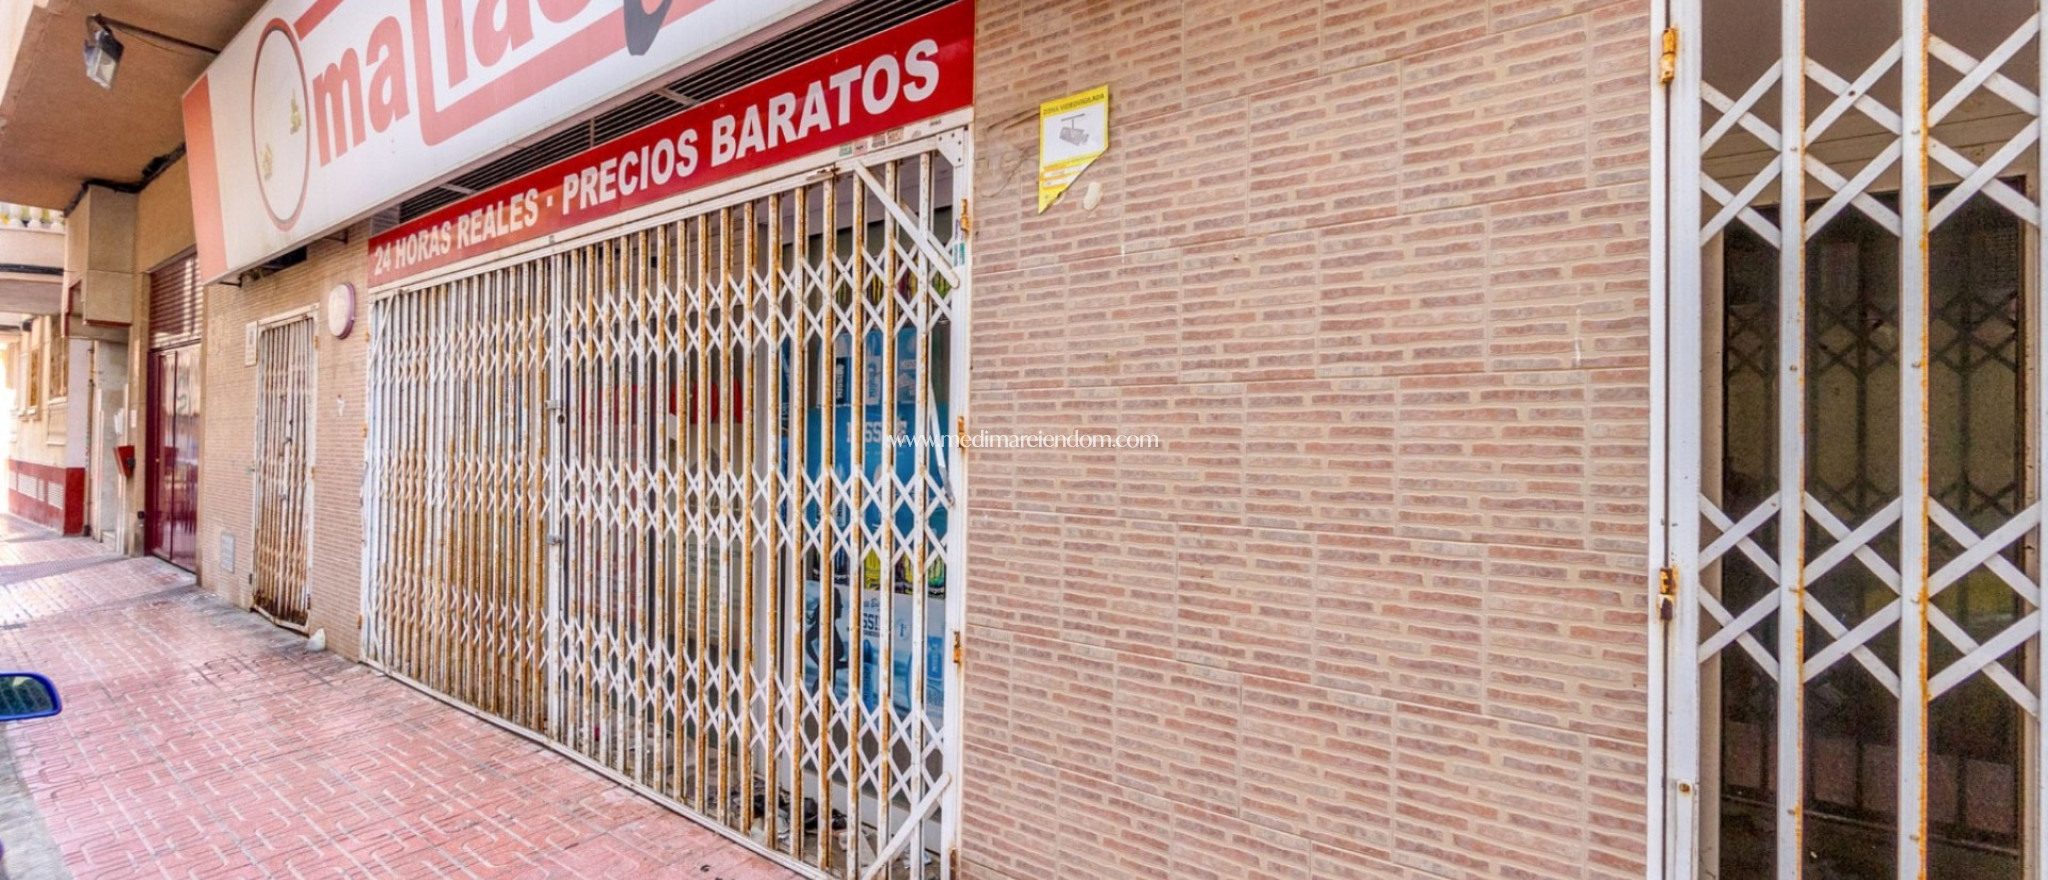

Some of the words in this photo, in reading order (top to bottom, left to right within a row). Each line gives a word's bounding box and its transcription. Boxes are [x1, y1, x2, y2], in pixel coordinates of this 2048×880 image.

[374, 243, 391, 276] 24
[395, 221, 451, 269] HORAS
[457, 188, 539, 249] REALES
[562, 128, 699, 215] PRECIOS
[711, 38, 940, 168] BARATOS
